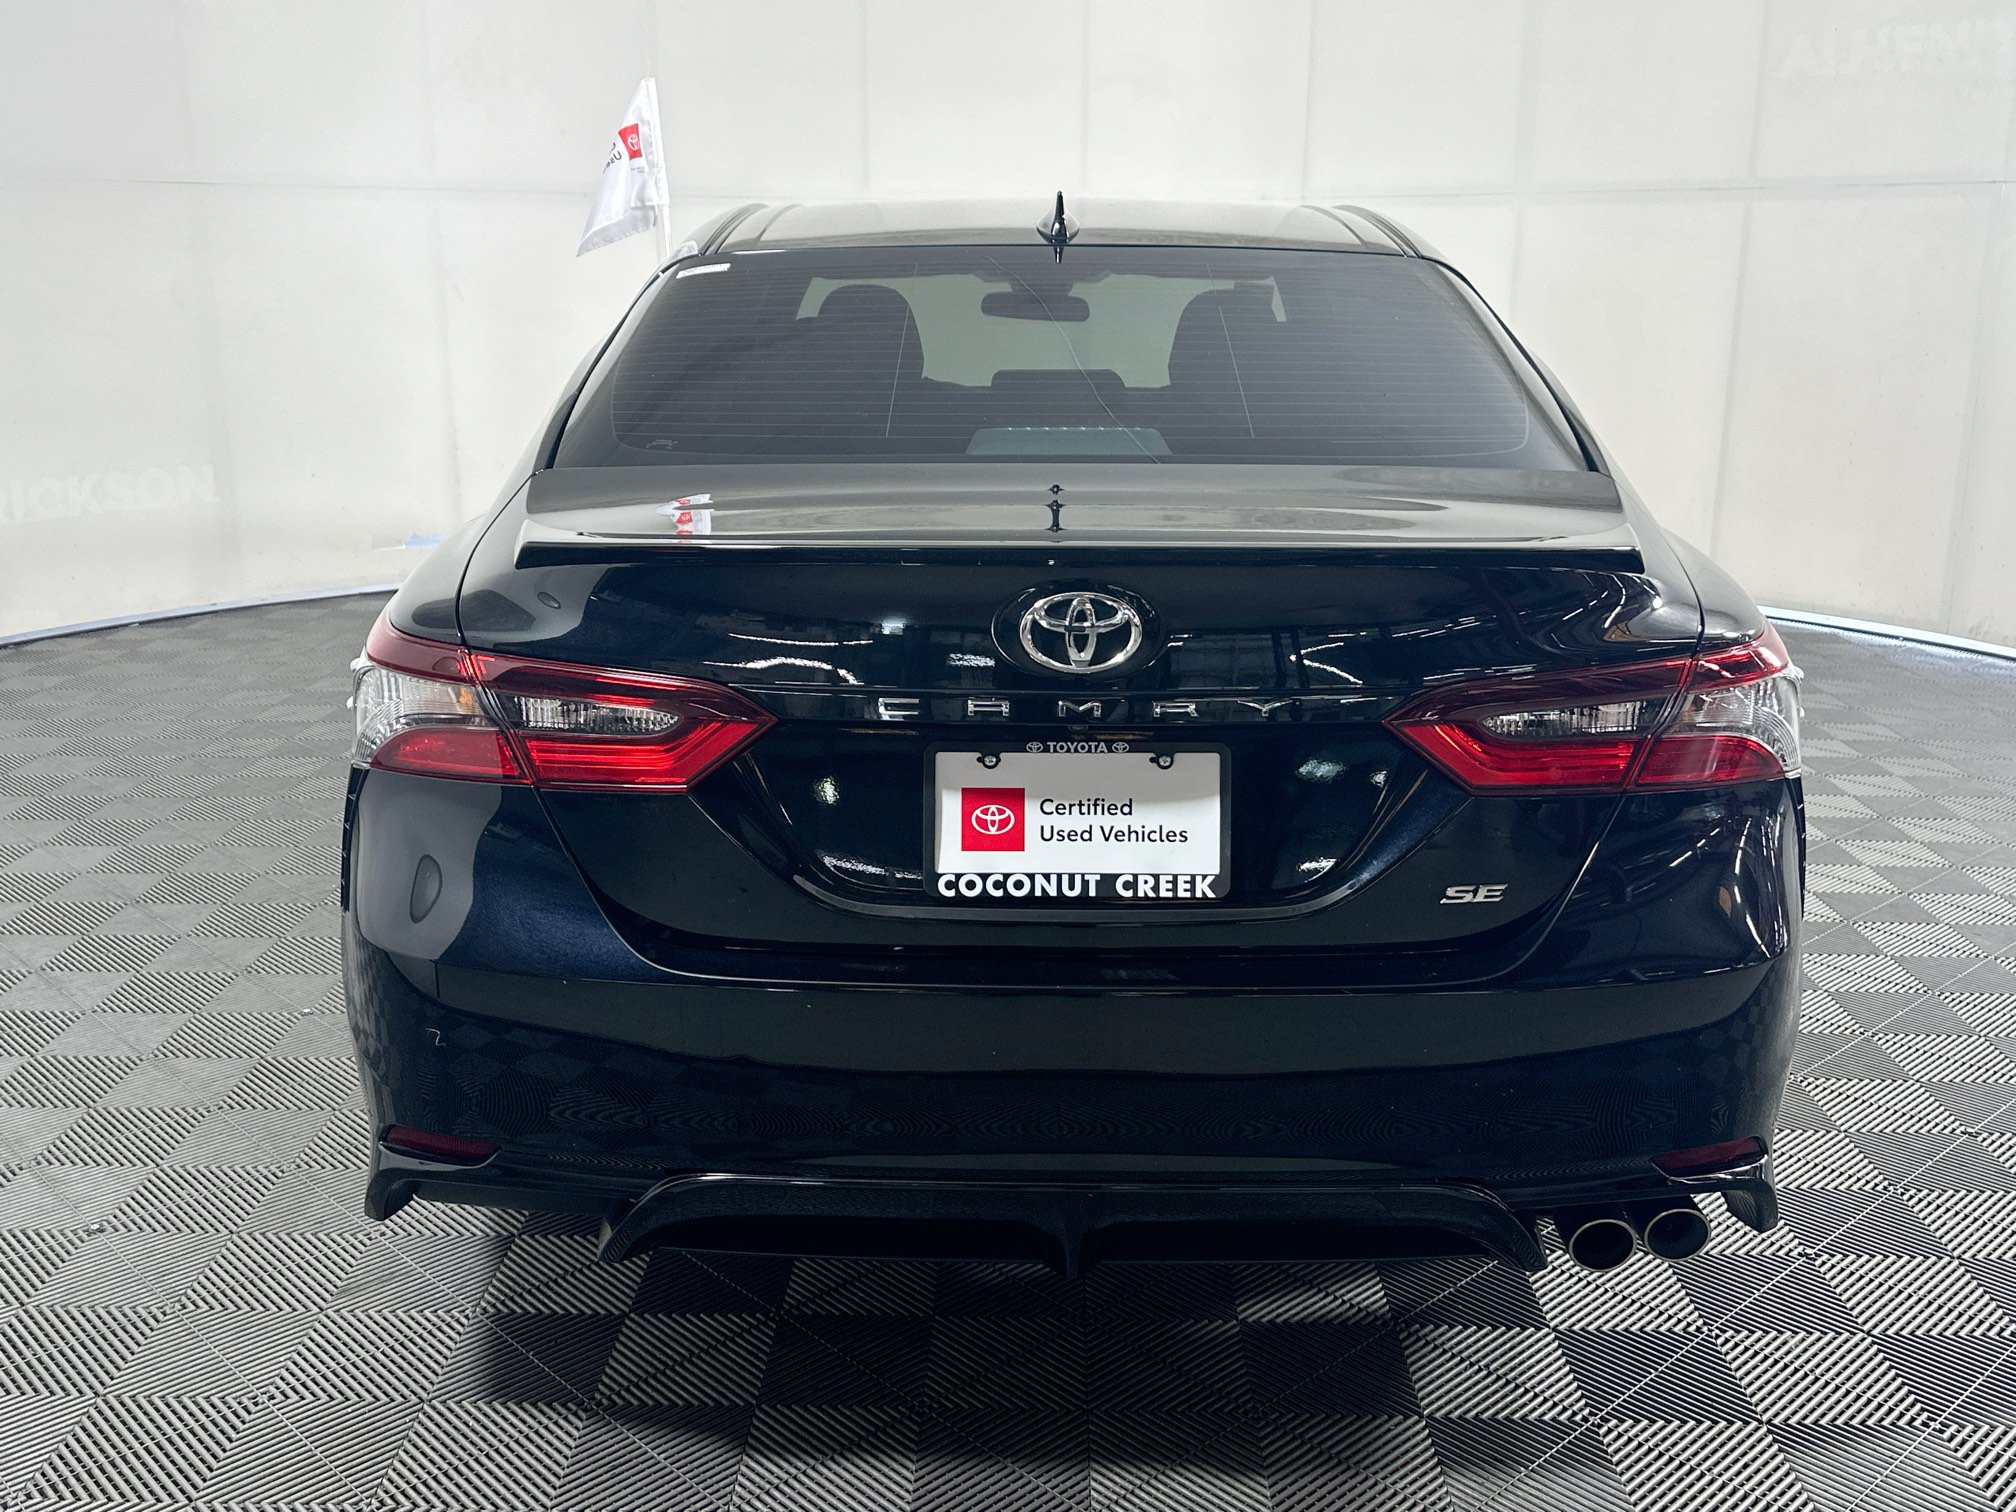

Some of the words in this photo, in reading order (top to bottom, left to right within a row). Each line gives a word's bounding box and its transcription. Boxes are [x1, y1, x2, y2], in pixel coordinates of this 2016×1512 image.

[878, 697, 1298, 718] CAMRY
[1047, 742, 1109, 754] TOYOTA
[1039, 798, 1133, 816] Certified
[1039, 825, 1093, 843] Used
[1100, 825, 1188, 843] Vehicles
[937, 873, 1101, 898] COCONUT
[1115, 873, 1217, 898] CREEK
[1439, 884, 1509, 904] SE
